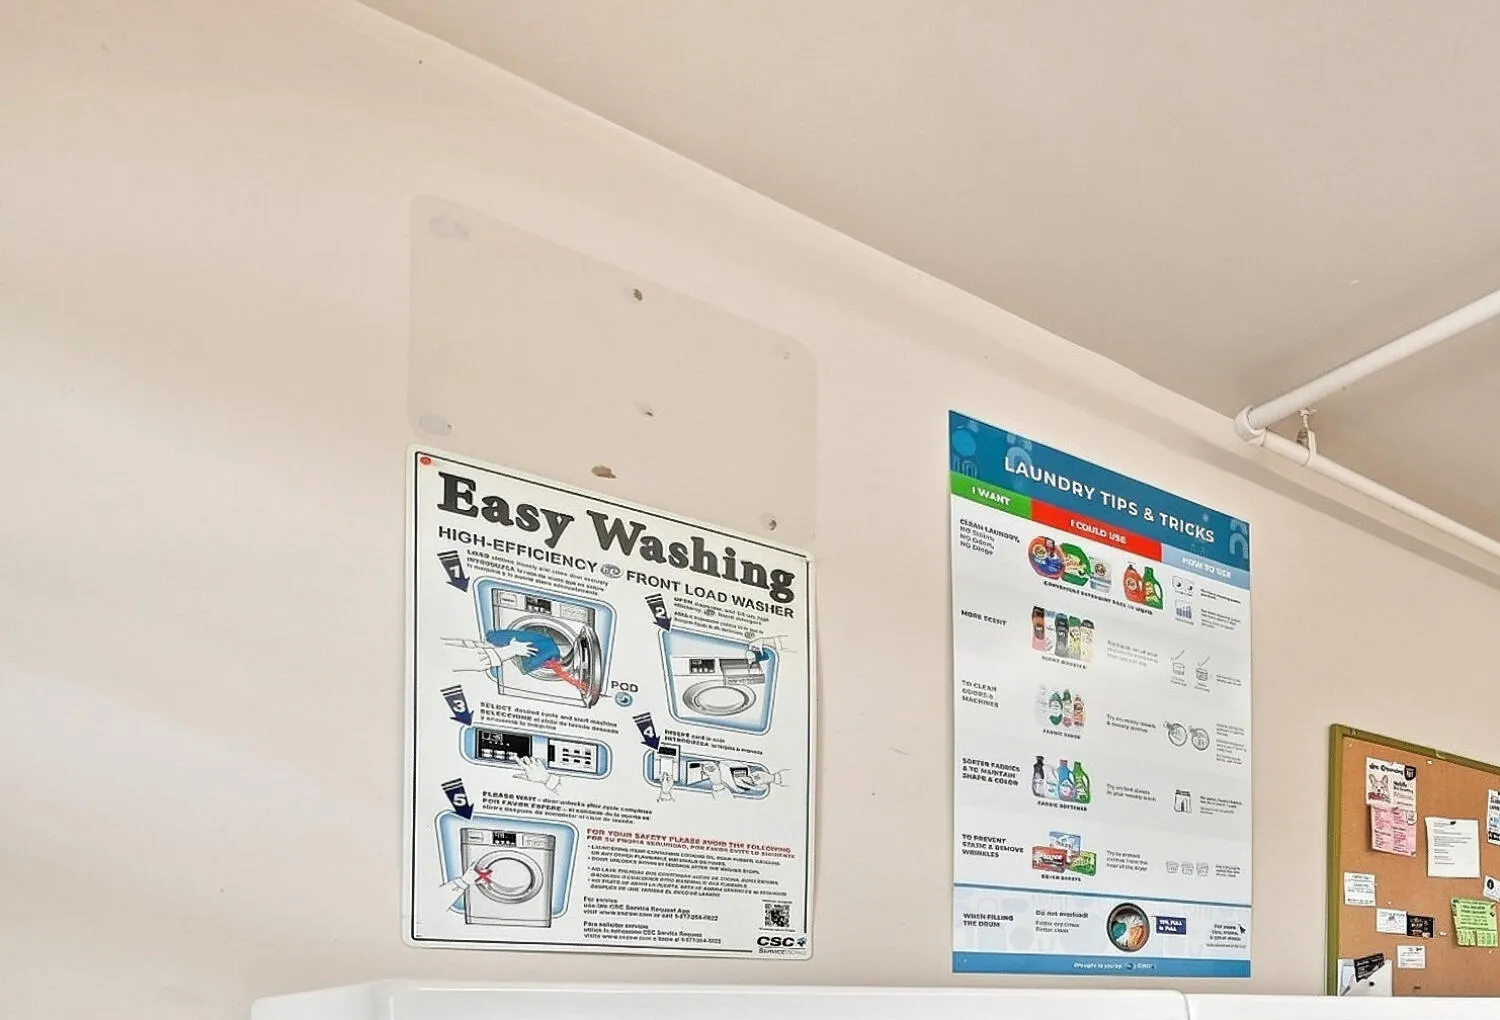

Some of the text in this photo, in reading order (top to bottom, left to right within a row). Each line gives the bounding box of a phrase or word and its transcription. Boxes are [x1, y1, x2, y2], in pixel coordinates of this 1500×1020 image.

[977, 488, 1011, 505] WANT
[1004, 456, 1215, 543] LAUNDRY TIPS & TRICKS
[960, 519, 984, 531] CLEAN
[437, 471, 796, 604] Easy Washing
[1075, 521, 1107, 537] COULD
[1109, 530, 1127, 544] USE
[438, 525, 598, 575] HIGH-EFFICIENCY
[1182, 556, 1203, 569] HOW
[1204, 563, 1215, 573] TO
[450, 566, 460, 578] 1
[626, 570, 680, 592] FRONT
[685, 584, 728, 603] LOAD
[731, 594, 794, 619] WASHER
[654, 606, 665, 619] 2
[961, 609, 1007, 627] MORE SCENT
[611, 680, 638, 693] POD
[973, 682, 997, 692] CLEAN
[452, 700, 466, 713] 3
[480, 701, 511, 711] SELECT
[962, 695, 999, 708] MACHINES
[962, 757, 1020, 772] SOFTER FABRICS
[962, 773, 986, 782] SHAPE
[994, 778, 1019, 786] COLOR
[980, 768, 1016, 779] MAINTAIN
[453, 794, 466, 807] 5
[482, 791, 515, 799] PLEASE
[516, 794, 537, 802] WAIT
[501, 800, 529, 808] FAVOR
[531, 803, 562, 811] ESPERE
[587, 828, 605, 836] FOR
[608, 830, 632, 838] YOUR
[634, 832, 667, 842] SAFETY
[669, 836, 700, 844] PLEASE
[702, 839, 727, 847] AVOID
[746, 844, 791, 853] FOLLOWING
[973, 835, 1006, 844] PREVENT
[962, 841, 987, 850] STATIC
[995, 845, 1024, 853] REMOVE
[962, 849, 1000, 858] WRINKLES
[625, 904, 650, 912] Service
[757, 936, 795, 947] CSC
